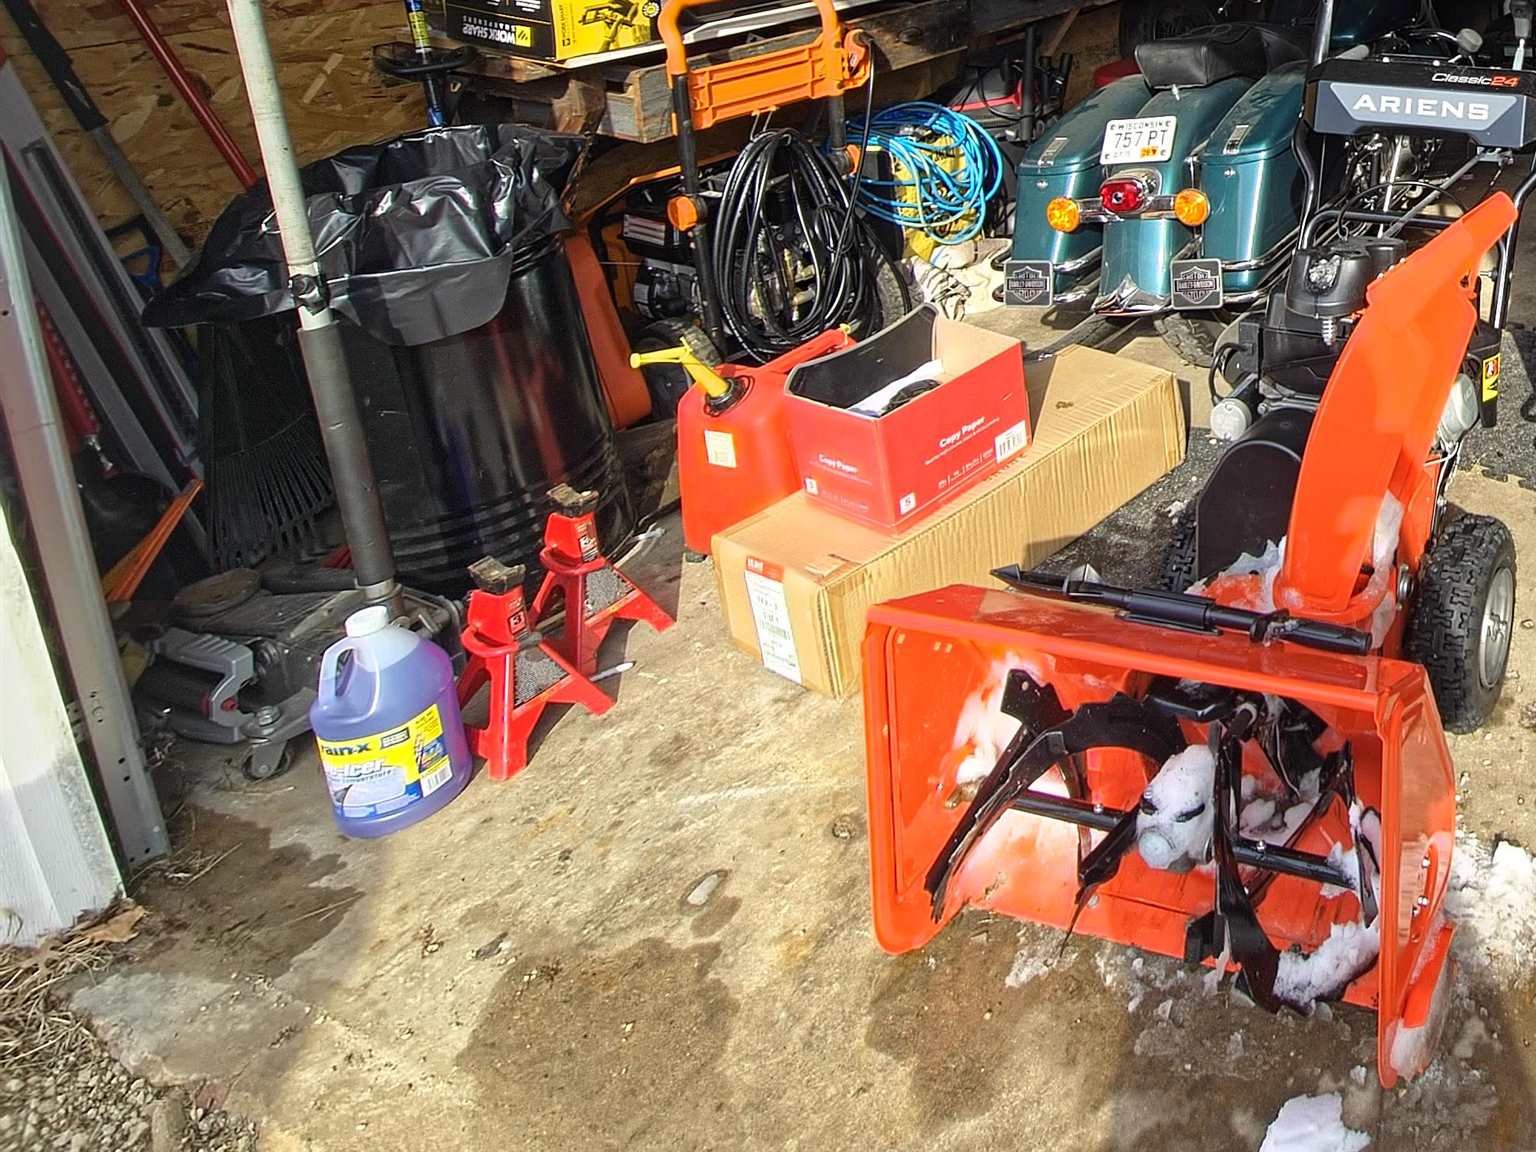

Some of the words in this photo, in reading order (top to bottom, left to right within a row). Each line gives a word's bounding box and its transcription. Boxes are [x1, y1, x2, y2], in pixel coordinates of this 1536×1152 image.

[462, 22, 489, 41] SHARP
[488, 27, 517, 45] WORK
[1352, 93, 1489, 120] ARIENS
[1118, 120, 1163, 131] WISCONSIN
[1114, 130, 1143, 149] 757
[1147, 129, 1169, 146] PT
[938, 429, 961, 448] Copy
[961, 416, 986, 436] Paper
